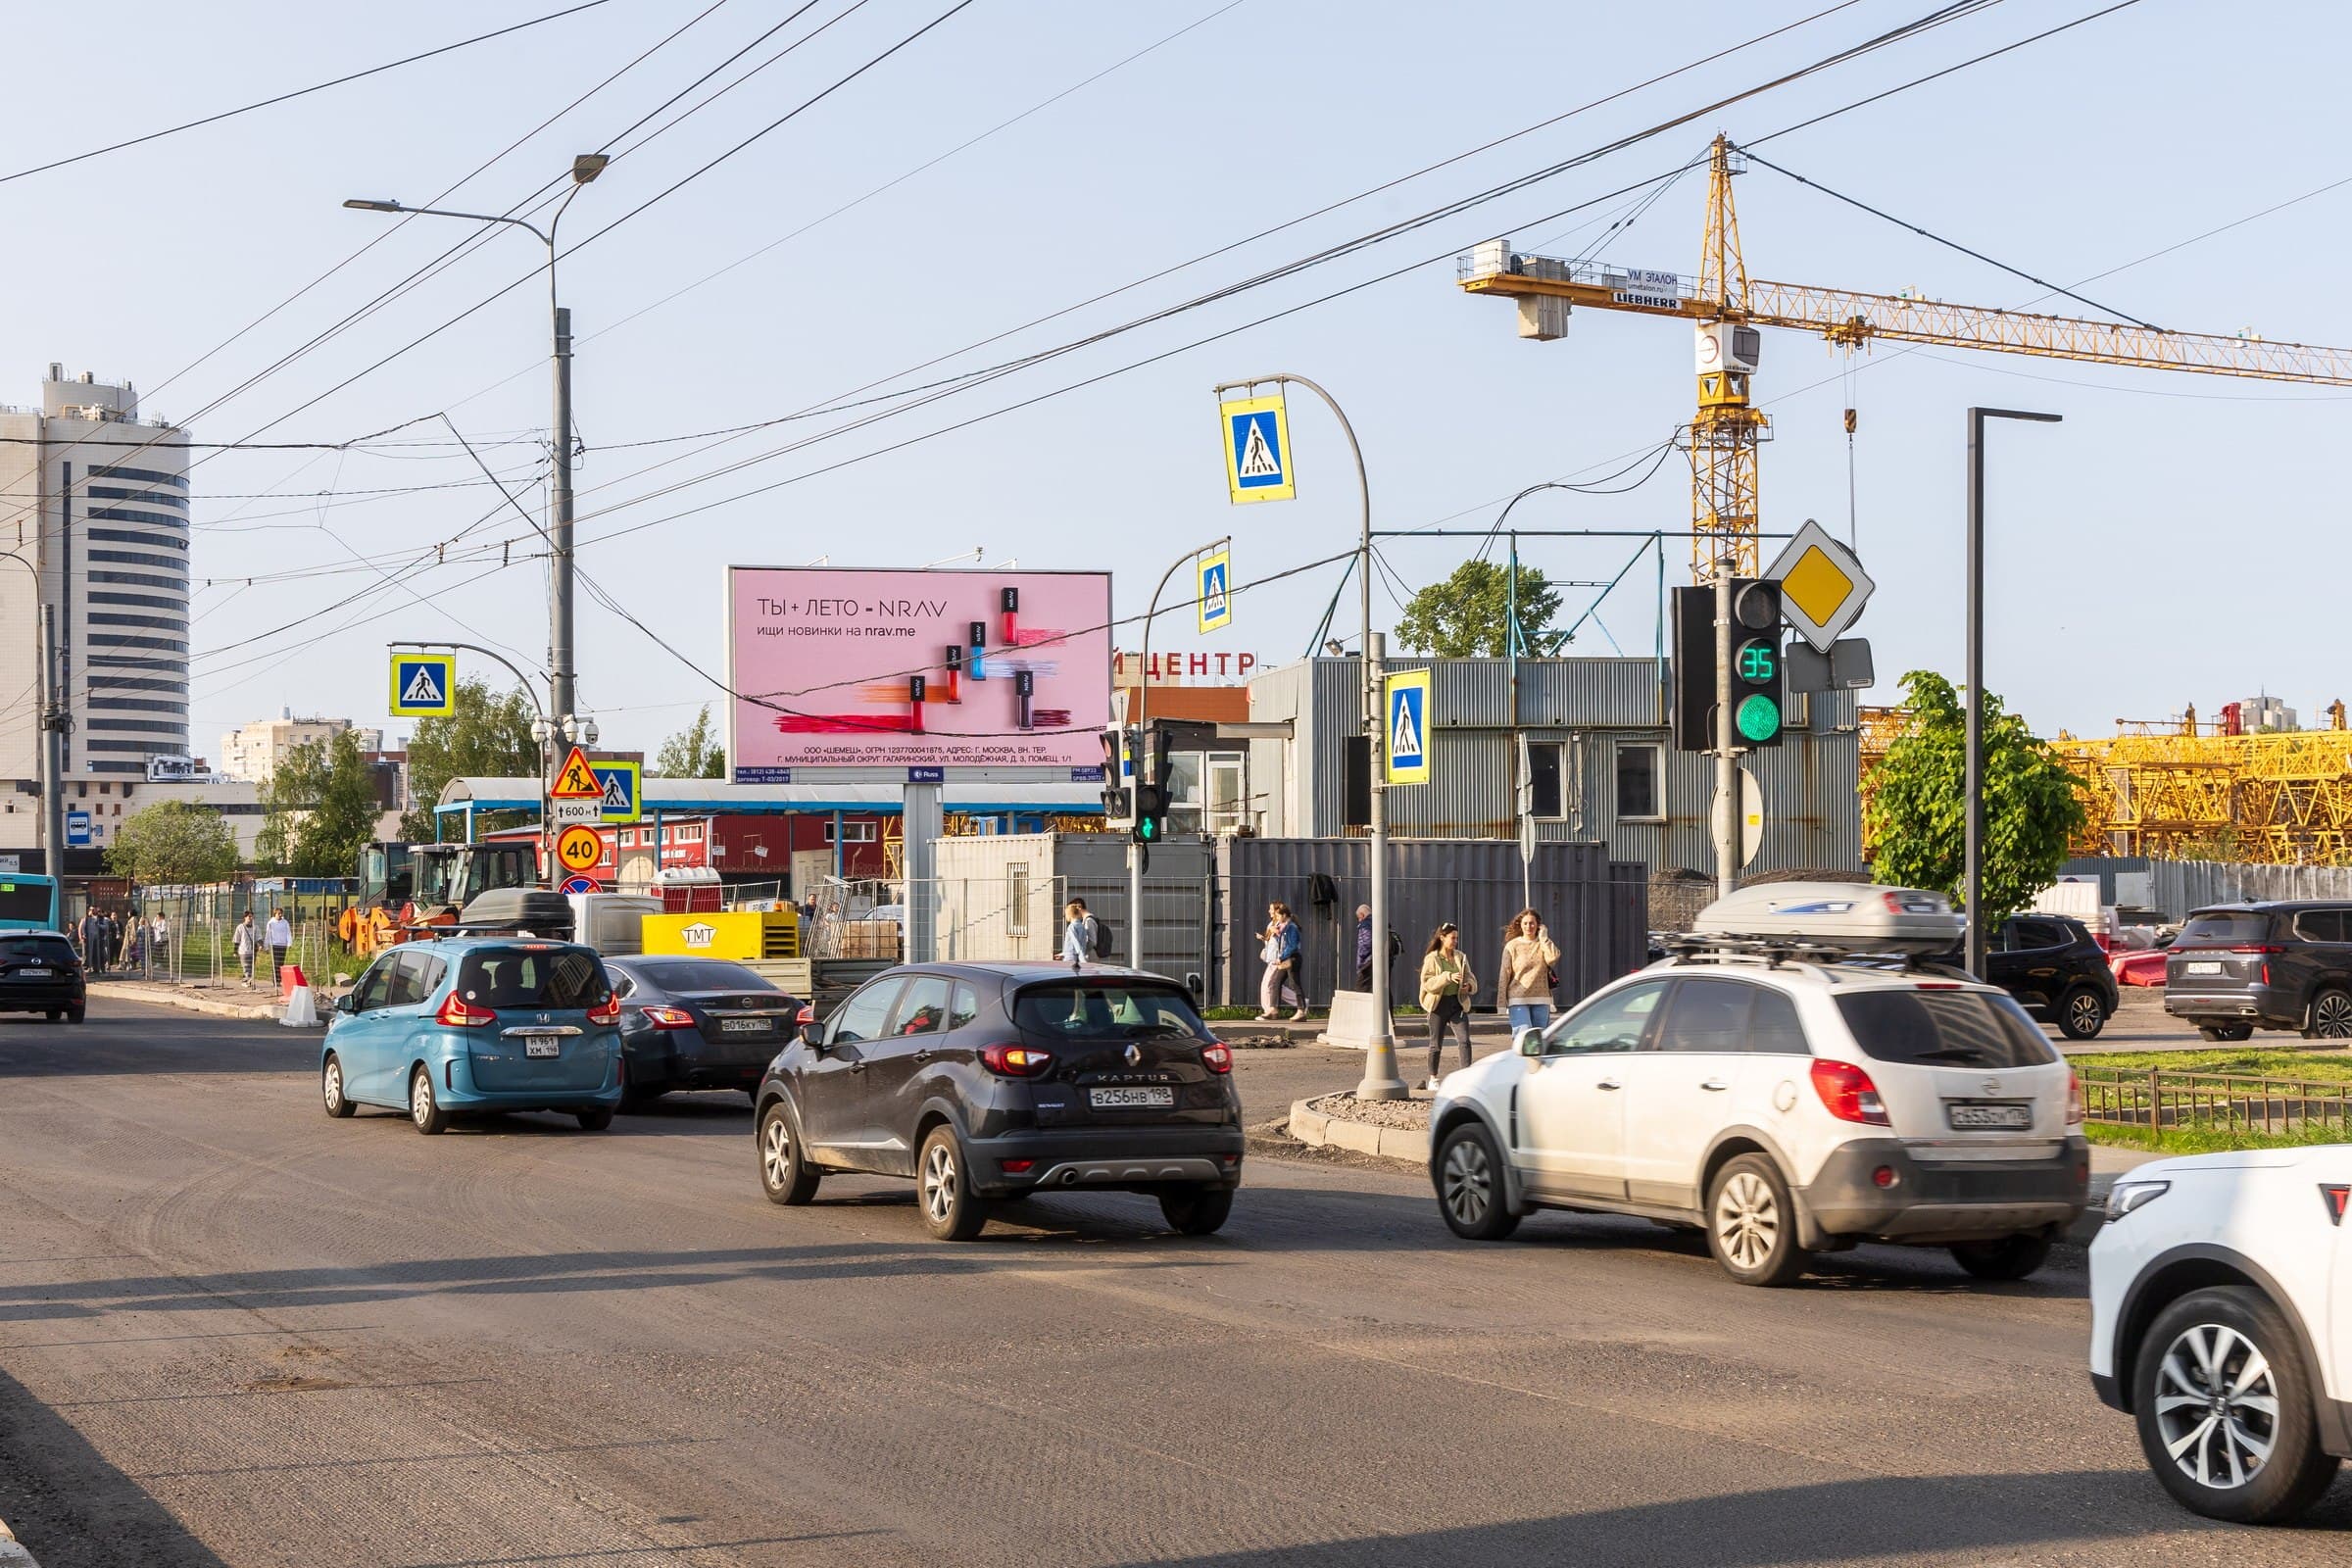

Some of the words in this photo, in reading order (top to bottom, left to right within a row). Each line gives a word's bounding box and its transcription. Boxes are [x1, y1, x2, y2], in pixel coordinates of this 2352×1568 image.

[1627, 269, 1642, 281] УМ
[1645, 271, 1678, 285] ЭТАЛОН
[1627, 283, 1664, 293] umetalon.ru
[1616, 293, 1678, 309] LIEBHERR
[757, 598, 786, 615] ТЫ
[805, 599, 858, 616] ЛЕТО
[879, 600, 947, 617] NRAV
[757, 626, 784, 637] ищи
[788, 626, 842, 636] новинки
[846, 627, 861, 636] на
[864, 626, 916, 637] nrav.me
[1140, 653, 1255, 680] ЦЕНТР
[1743, 648, 1773, 678] 35
[804, 746, 821, 755] ООО
[865, 746, 886, 755] ОГРН
[946, 746, 972, 755] АДРЕС:
[982, 746, 1016, 755] МОСКВА,
[784, 755, 856, 764] МУНИЦИПАЛЬНЫЙ
[565, 807, 585, 816] 600
[565, 841, 593, 858] 40
[1095, 1089, 1148, 1104] В256НВ
